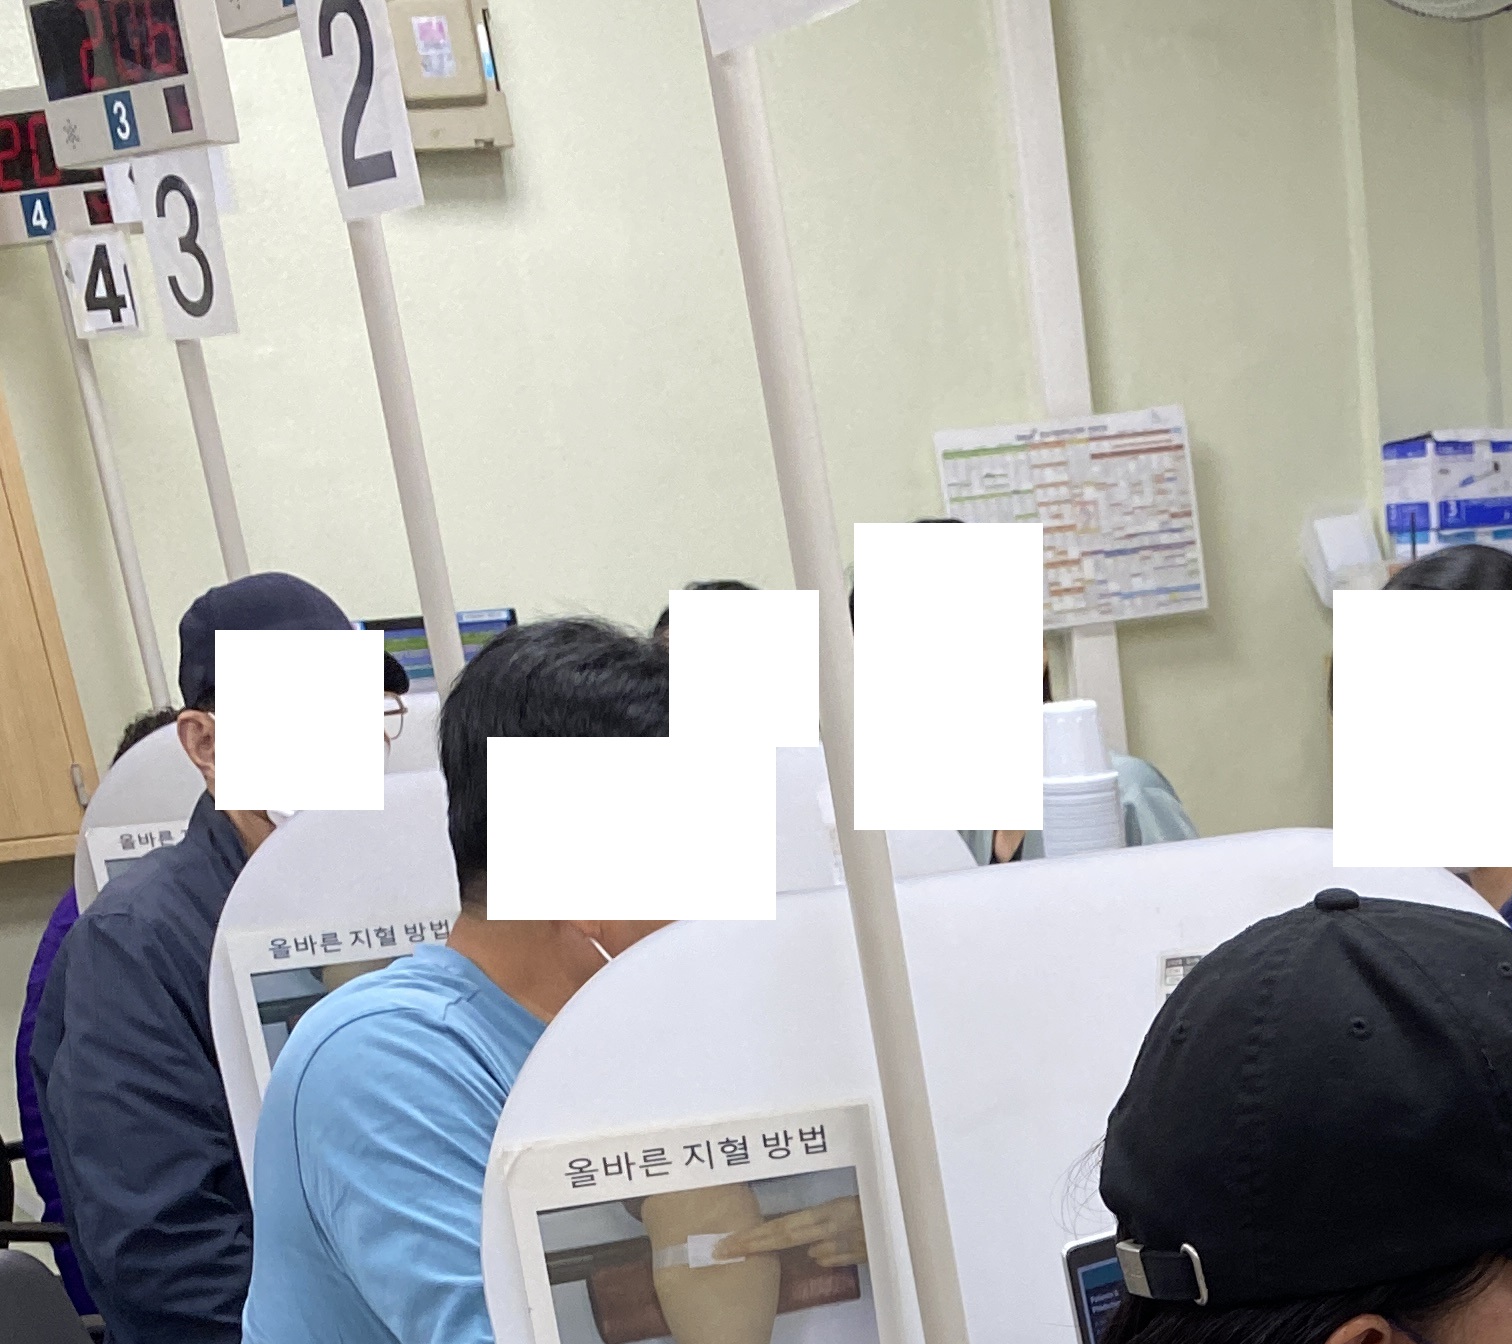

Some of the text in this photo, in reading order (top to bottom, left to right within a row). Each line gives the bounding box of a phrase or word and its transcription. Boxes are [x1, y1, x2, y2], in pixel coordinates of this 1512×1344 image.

[112, 100, 130, 141] 3
[319, 0, 397, 189] 2
[31, 198, 48, 230] 4
[155, 174, 214, 318] 3
[85, 244, 127, 324] 4
[119, 829, 174, 850] 올바른
[268, 919, 450, 960] 올바른 지혈 방법
[565, 1125, 828, 1188] 올바른 지혈 방법
